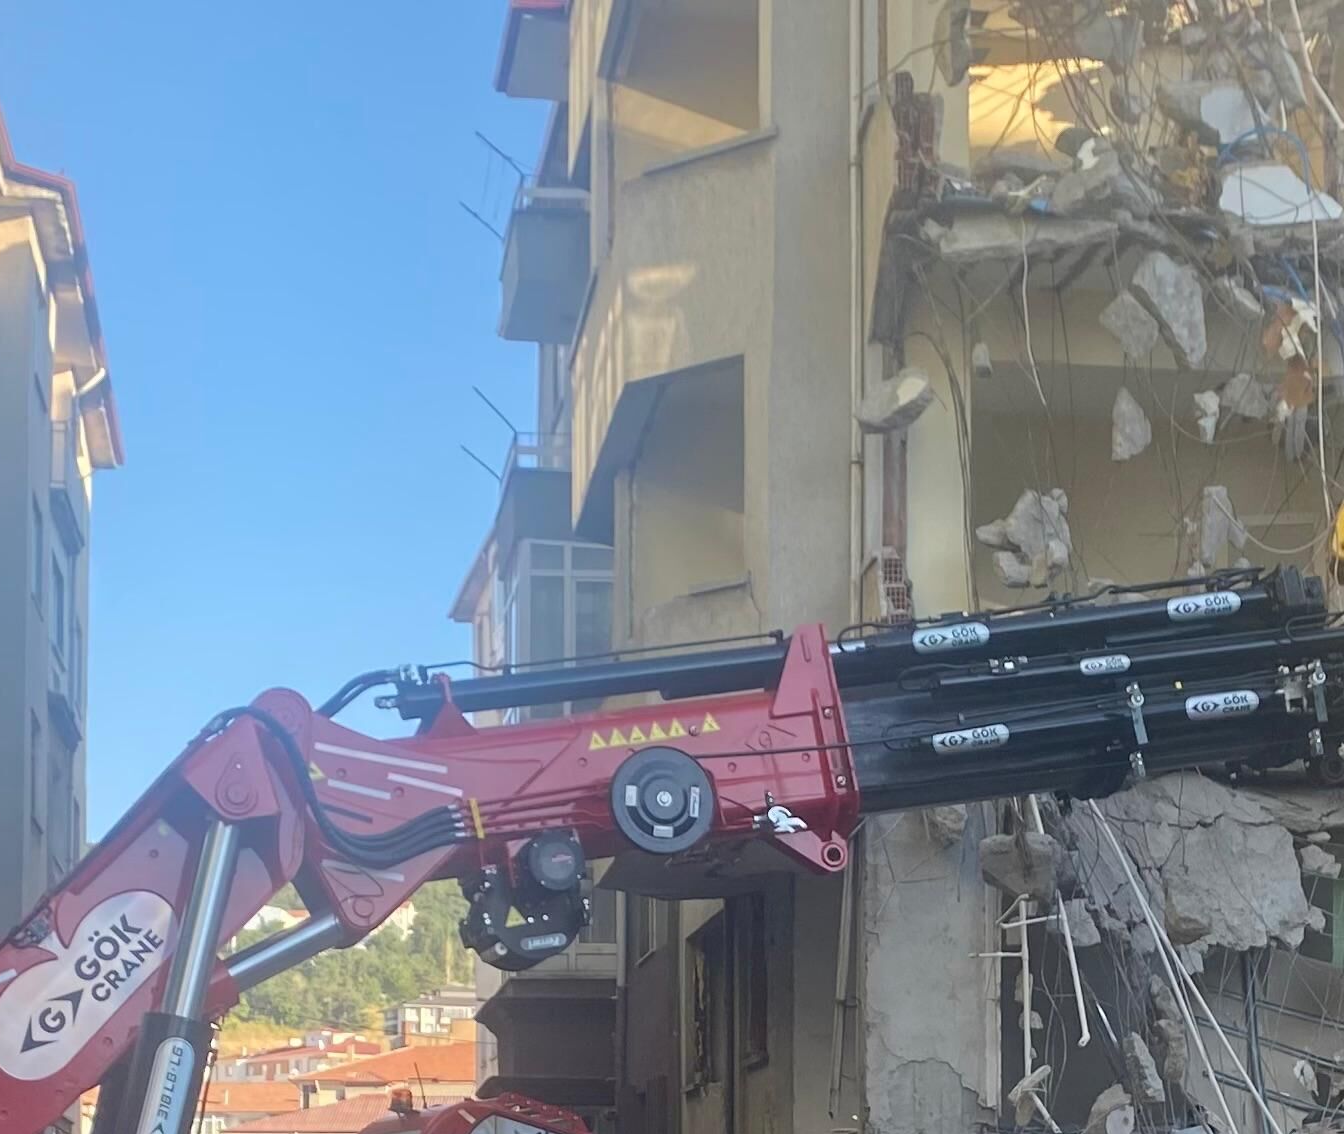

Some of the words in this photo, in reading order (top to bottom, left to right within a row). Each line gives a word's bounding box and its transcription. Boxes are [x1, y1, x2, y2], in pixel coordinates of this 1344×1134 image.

[1205, 594, 1230, 606] GÖK
[952, 625, 976, 638] GÖK
[1223, 694, 1248, 705] GÖK
[74, 913, 142, 981] GÖK
[91, 929, 164, 1002] CRANE
